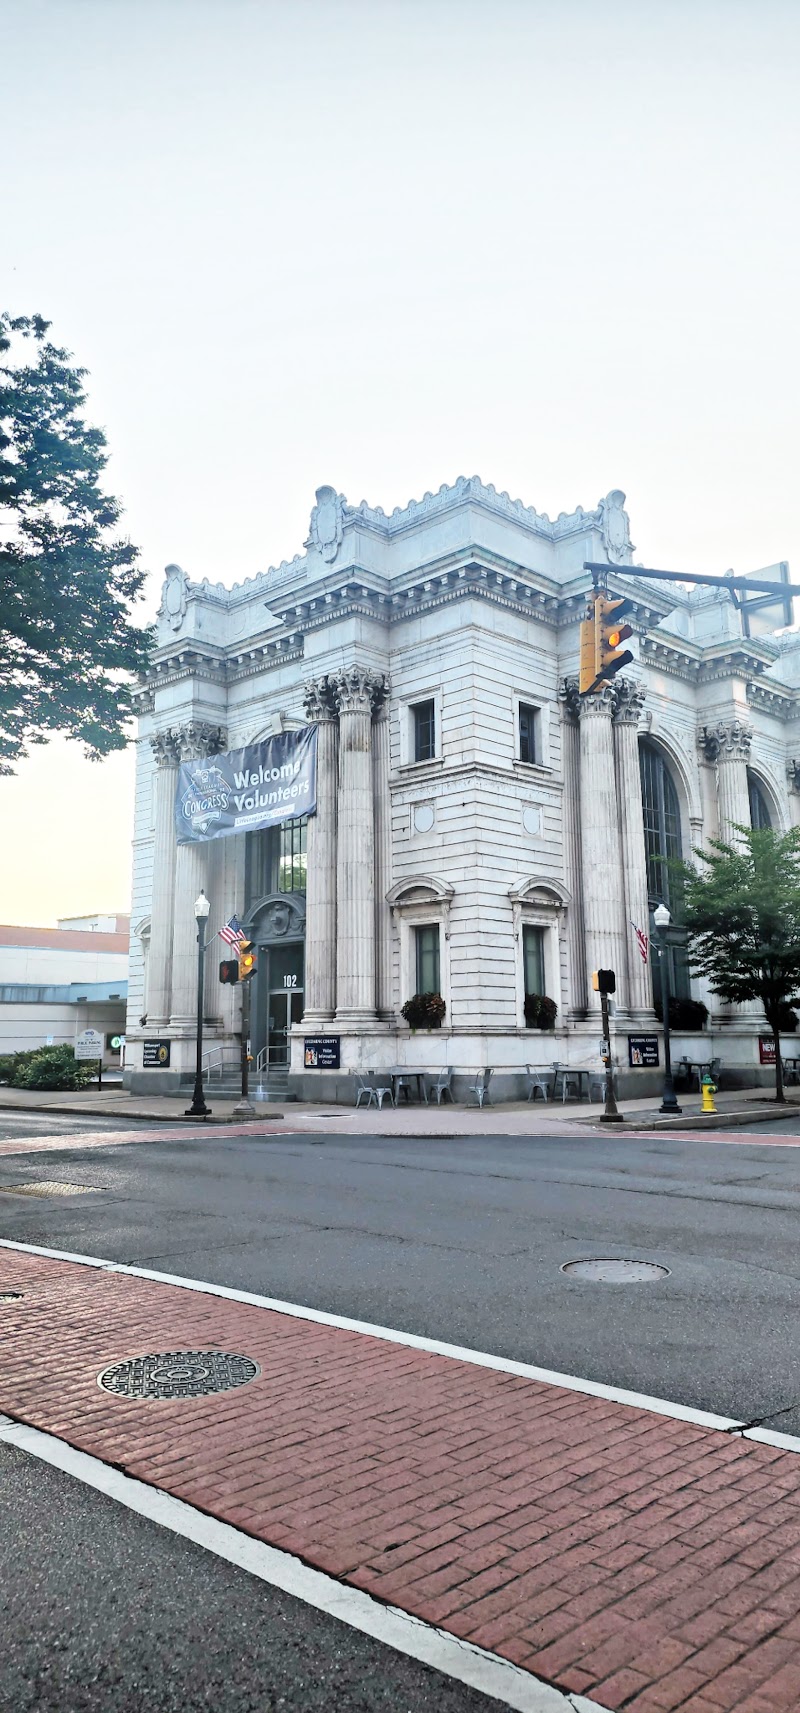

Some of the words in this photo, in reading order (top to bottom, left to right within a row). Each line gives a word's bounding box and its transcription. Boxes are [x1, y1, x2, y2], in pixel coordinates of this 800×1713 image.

[234, 760, 301, 790] Welcome
[184, 793, 227, 816] CONGRESS
[234, 780, 310, 812] Volunteers
[284, 975, 297, 987] 102
[763, 1043, 775, 1051] NEW
